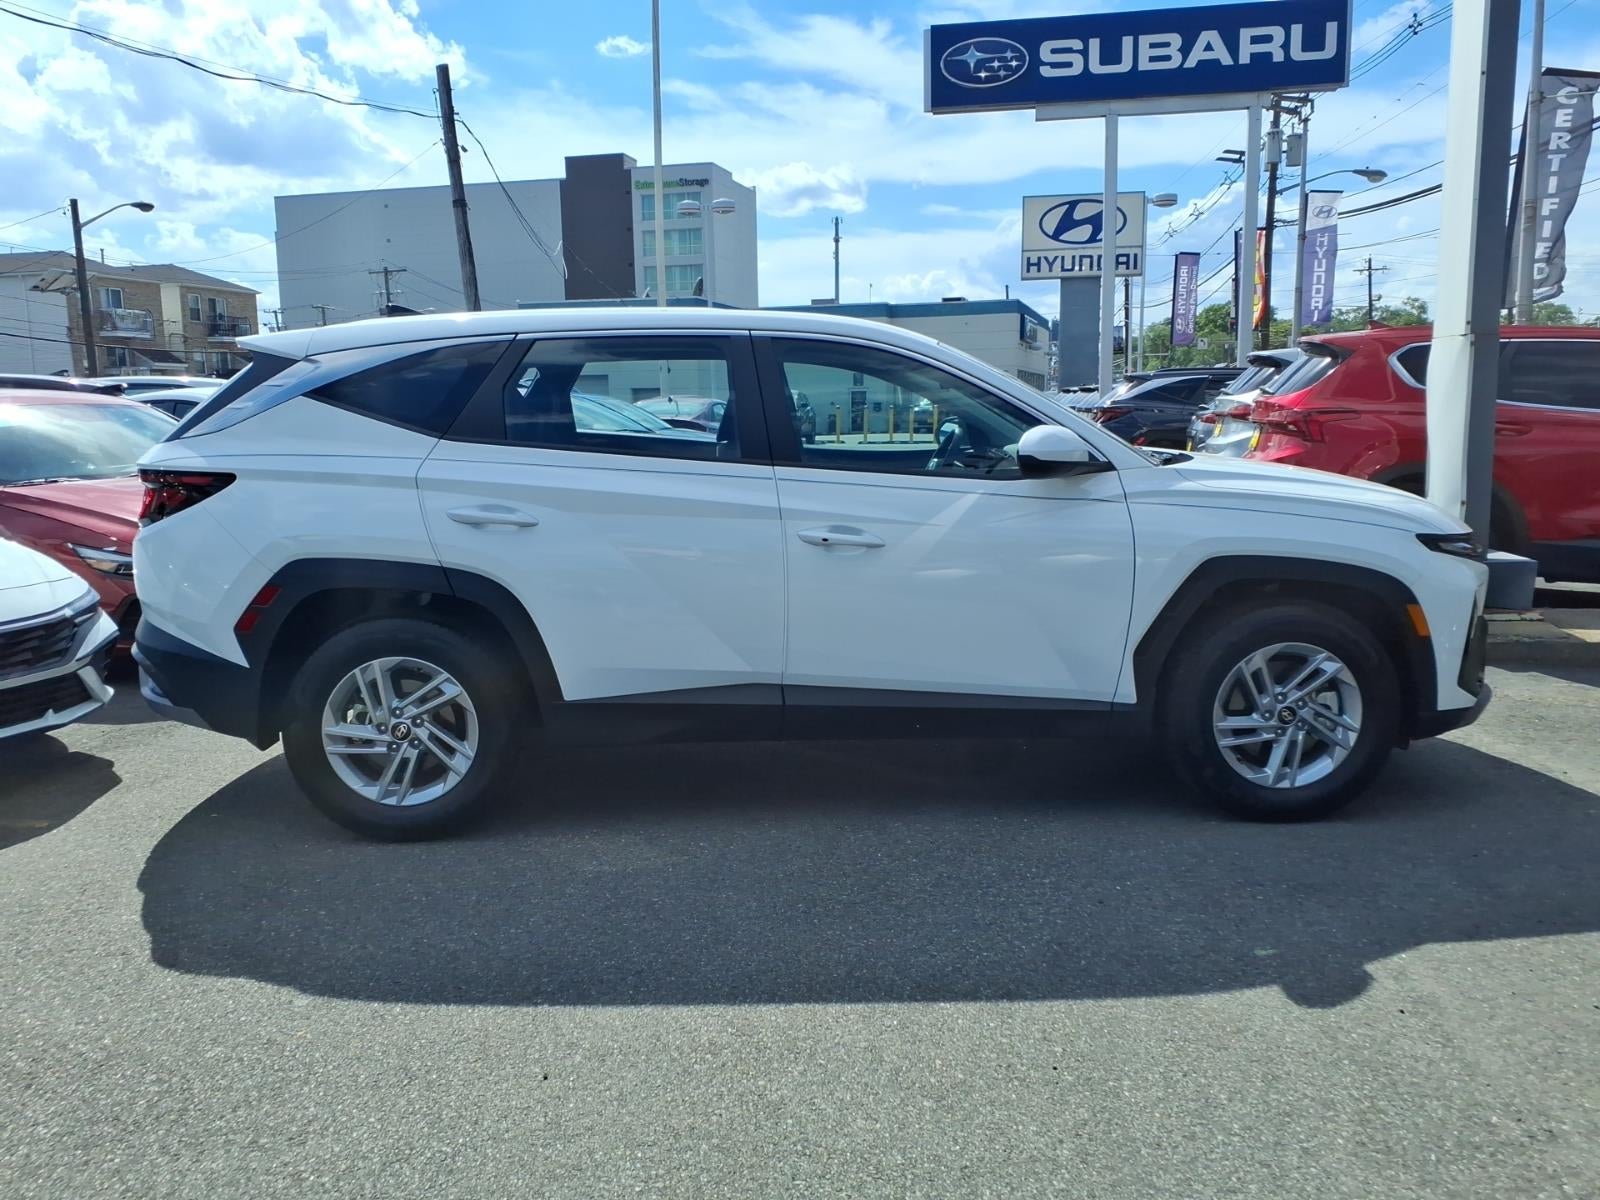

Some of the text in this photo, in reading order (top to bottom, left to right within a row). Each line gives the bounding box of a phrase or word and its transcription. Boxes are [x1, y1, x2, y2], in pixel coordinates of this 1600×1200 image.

[1039, 21, 1338, 77] SUBARU
[679, 178, 709, 187] Storage
[1533, 86, 1578, 280] CERTIFIED
[1178, 266, 1188, 313] HYUNDAI
[1311, 233, 1328, 321] HYUNDAI
